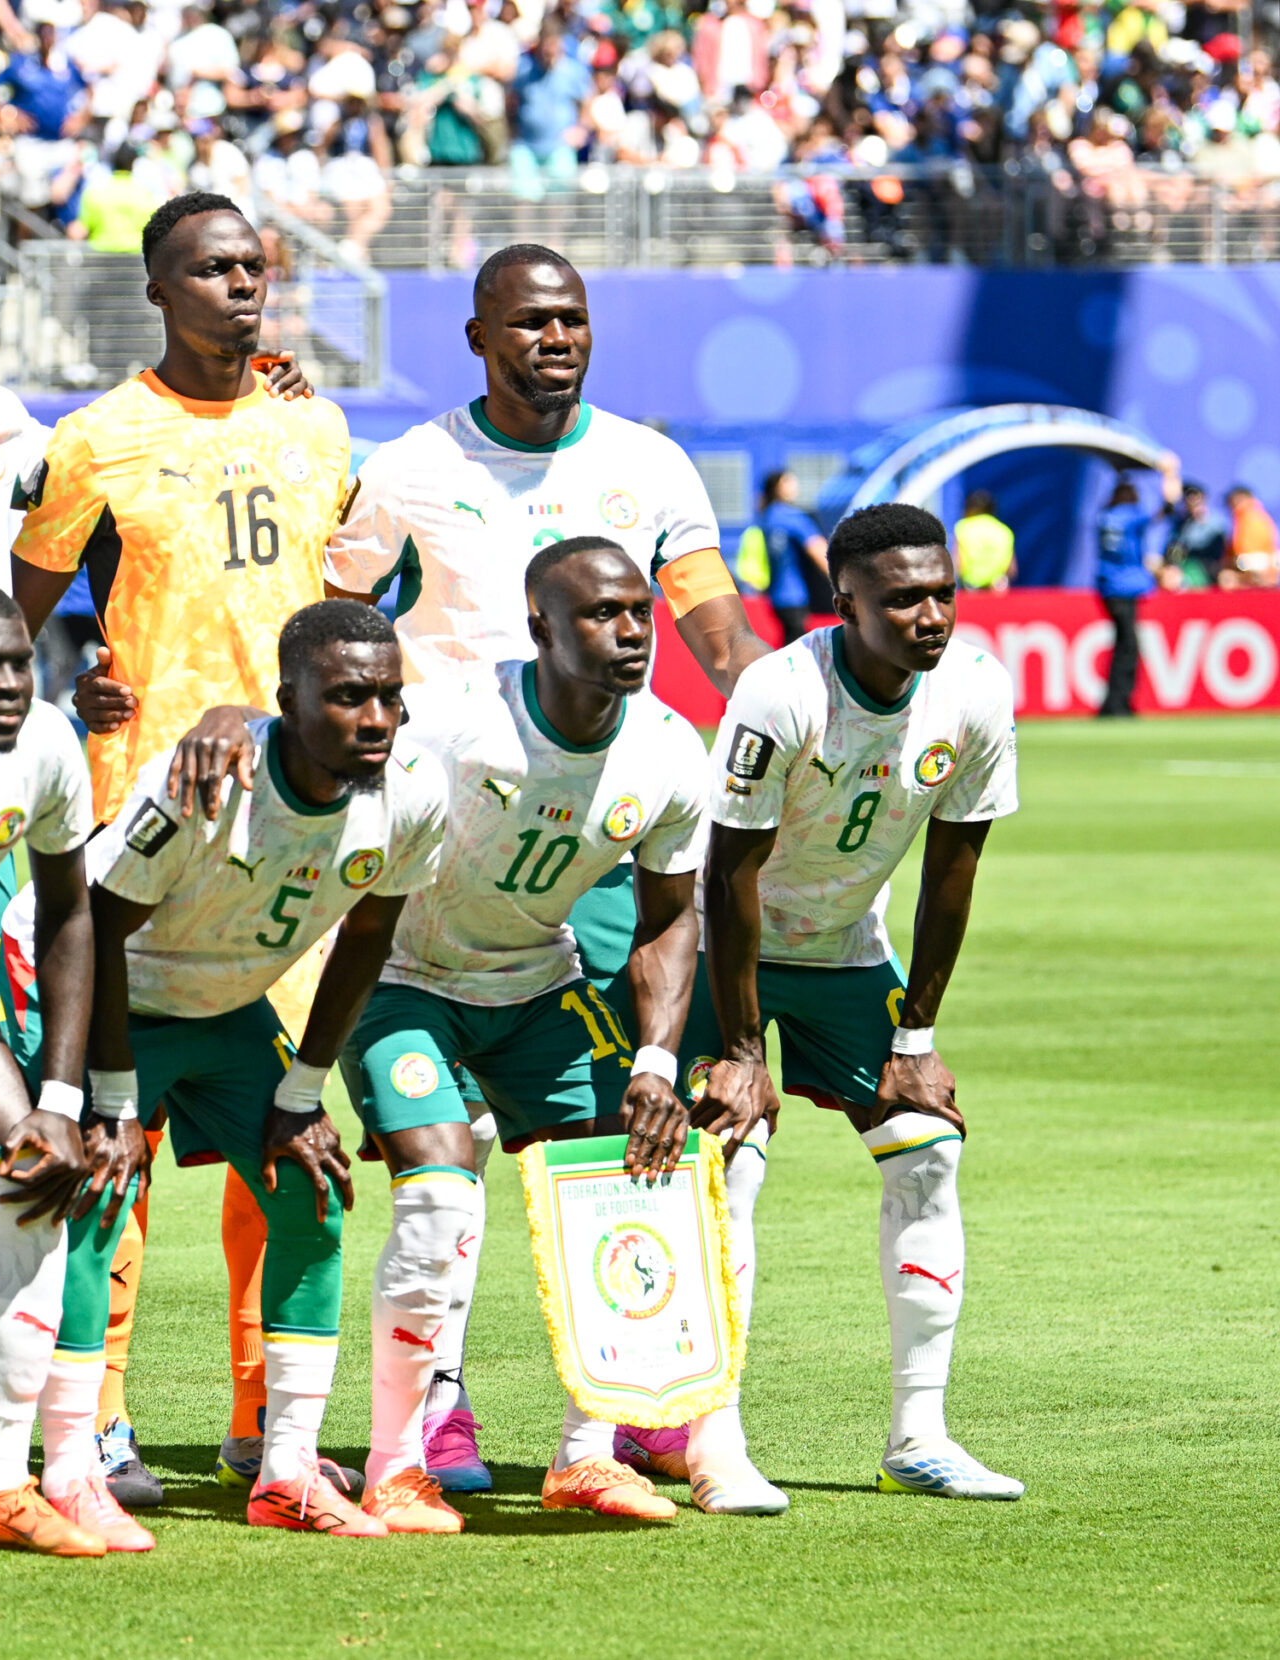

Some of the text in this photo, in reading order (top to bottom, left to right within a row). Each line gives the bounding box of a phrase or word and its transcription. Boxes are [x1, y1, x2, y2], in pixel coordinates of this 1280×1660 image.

[216, 485, 279, 570] 16
[837, 791, 881, 853] 8
[494, 828, 580, 895] 10
[255, 884, 313, 949] 5
[610, 1198, 659, 1215] FOOTBALL
